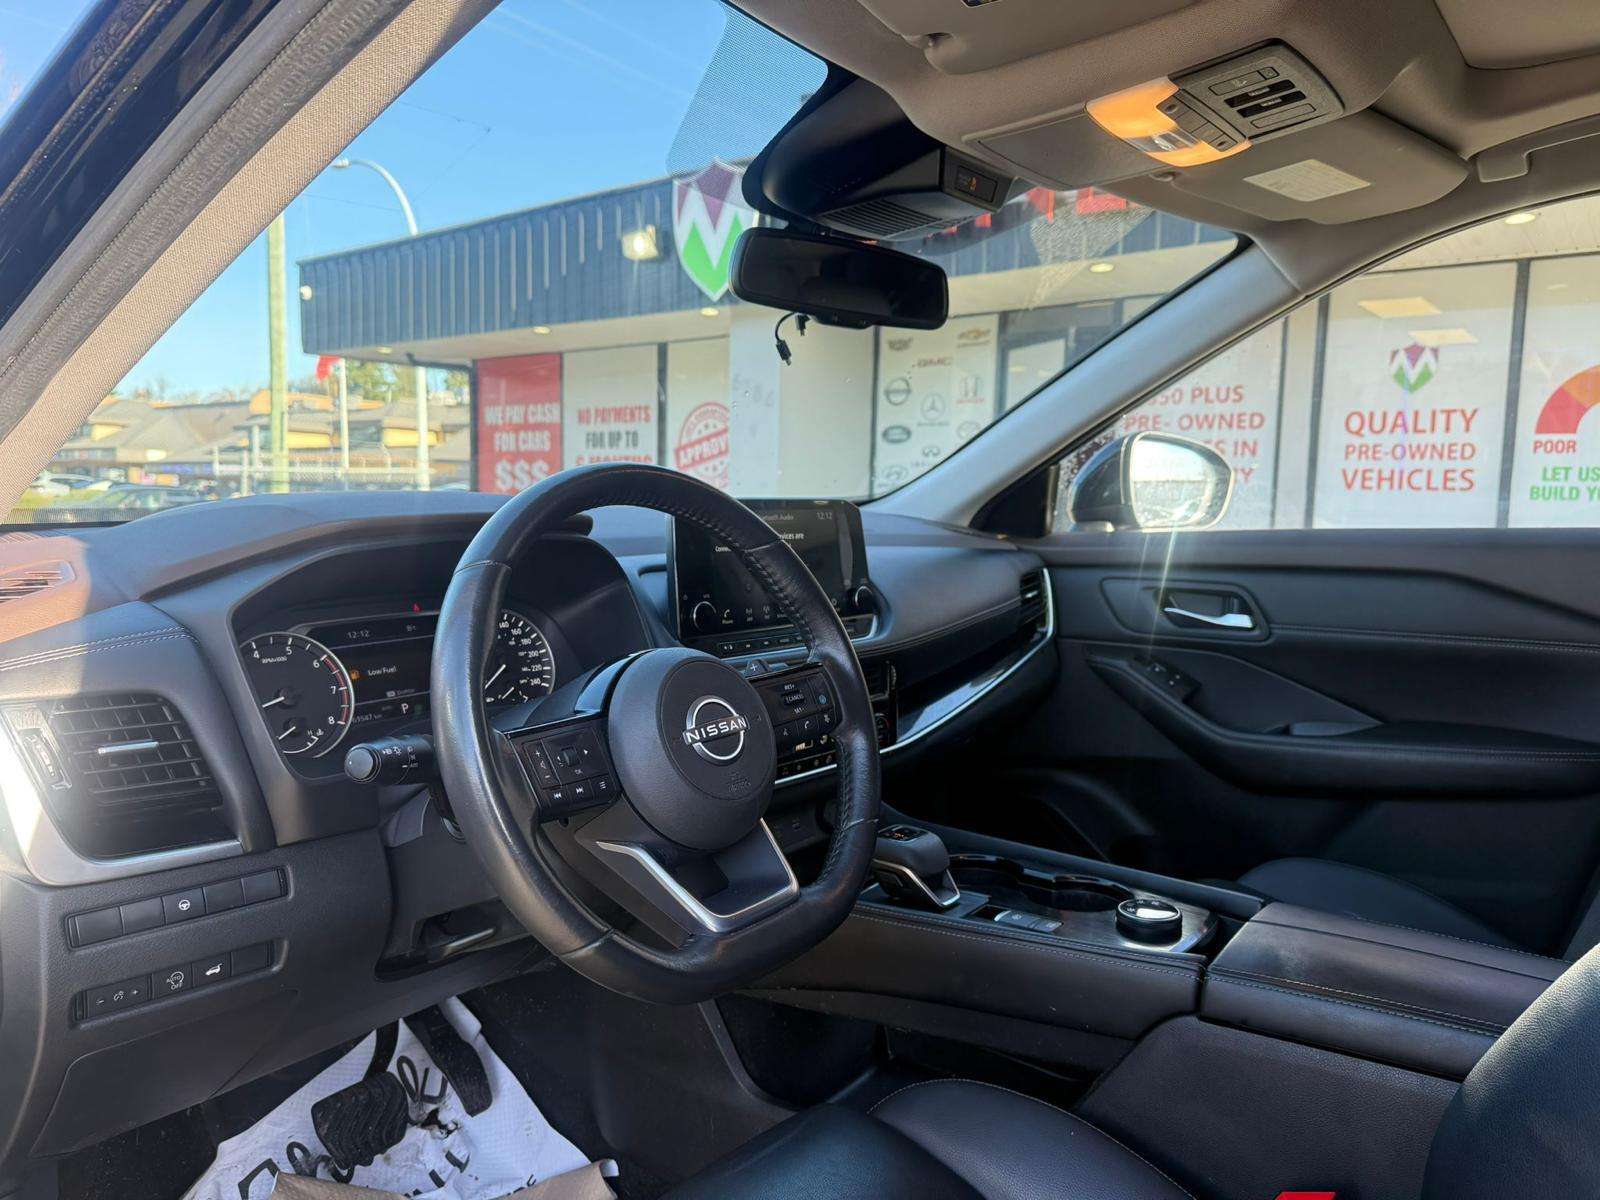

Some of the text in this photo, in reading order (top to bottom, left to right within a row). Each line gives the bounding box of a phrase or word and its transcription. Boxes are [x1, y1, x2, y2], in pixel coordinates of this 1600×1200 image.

[1191, 384, 1244, 404] PLUS
[594, 405, 653, 425] PAYMENTS
[1178, 412, 1266, 431] OWNED
[1344, 408, 1479, 437] QUALITY
[494, 431, 516, 452] FOR
[585, 430, 639, 449] FOR UP TO
[1533, 439, 1577, 454] POOR
[1232, 441, 1258, 458] IN
[1344, 442, 1477, 461] PRE-OWNED
[1341, 468, 1475, 491] VEHICLES
[1542, 466, 1600, 482] LET US
[1529, 485, 1600, 502] BUILD Y
[286, 646, 293, 655] 5
[313, 660, 320, 669] 6
[330, 685, 337, 694] 7
[401, 702, 409, 714] P
[328, 715, 335, 725] 8
[685, 718, 747, 745] NISSAN
